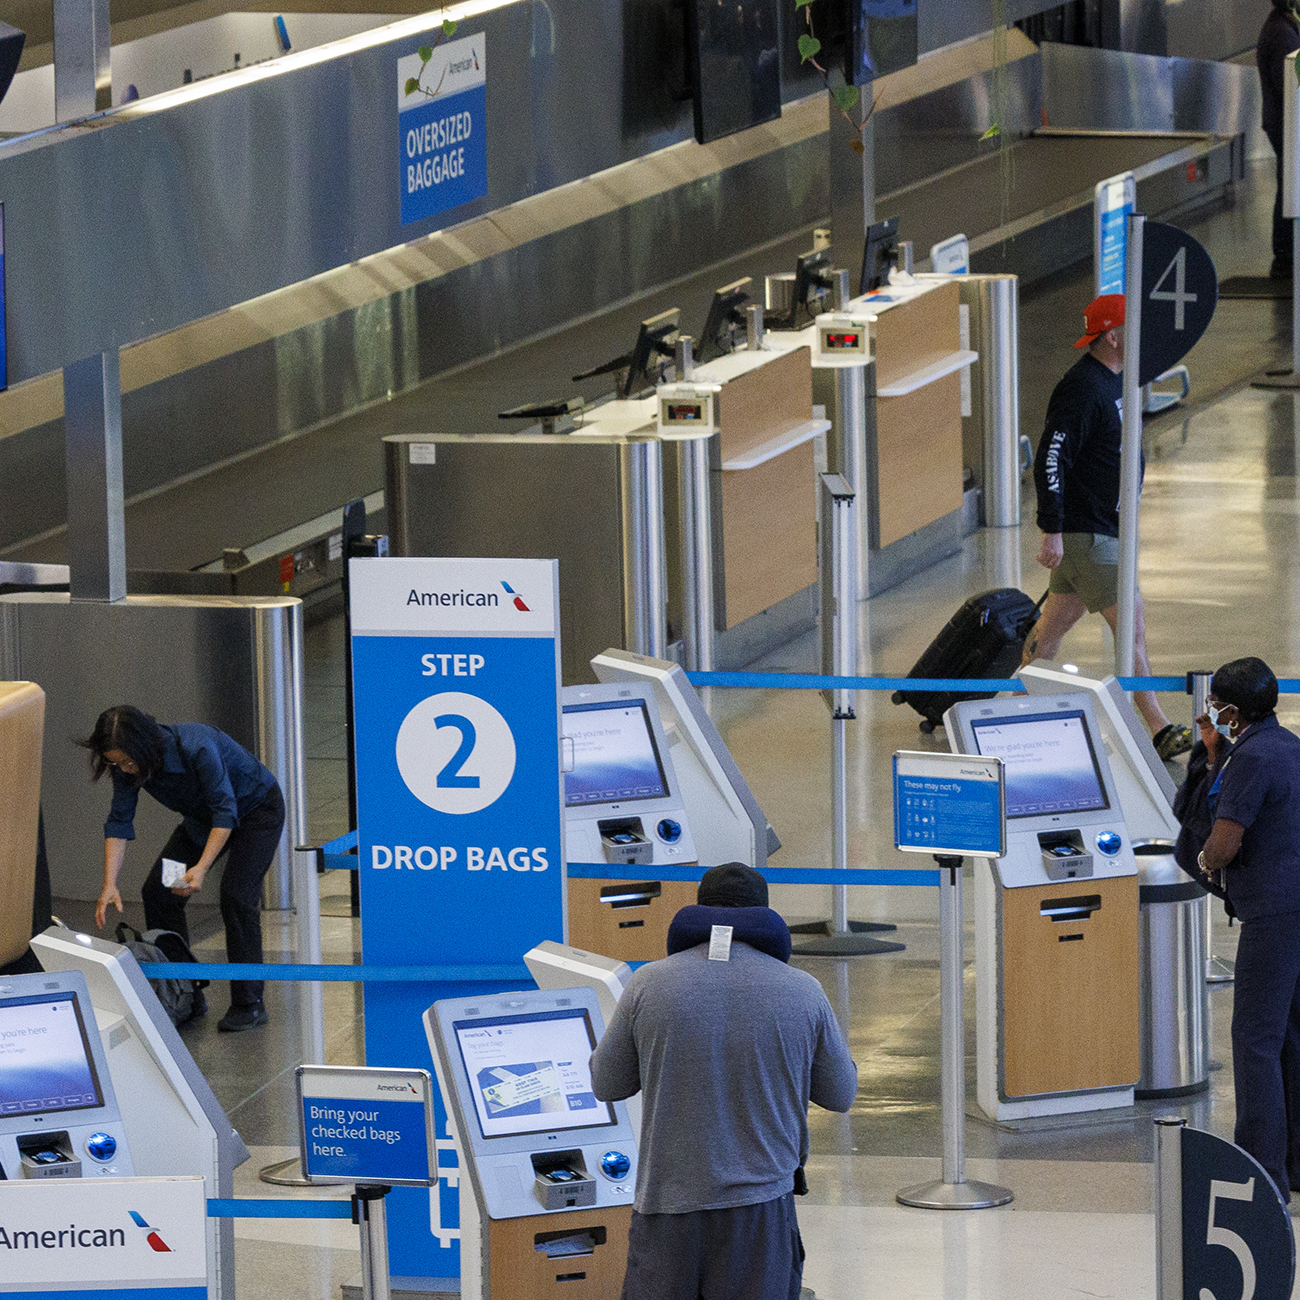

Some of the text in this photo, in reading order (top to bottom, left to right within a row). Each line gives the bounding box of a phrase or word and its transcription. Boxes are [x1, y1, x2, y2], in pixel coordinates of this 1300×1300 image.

[406, 111, 472, 158] OVERSIZED
[407, 147, 465, 194] BAGGAGE
[1149, 247, 1198, 330] 4
[406, 588, 499, 607] American
[421, 653, 486, 677] STEP
[433, 713, 481, 789] 2
[904, 780, 923, 789] These
[924, 783, 939, 792] may
[940, 783, 952, 791] not
[372, 845, 550, 872] DROP BAGS
[0, 1028, 27, 1041] you're
[27, 1026, 48, 1036] here
[377, 1084, 408, 1092] American
[310, 1105, 380, 1124] Bring your
[311, 1124, 401, 1145] checked bags
[312, 1142, 347, 1157] here.
